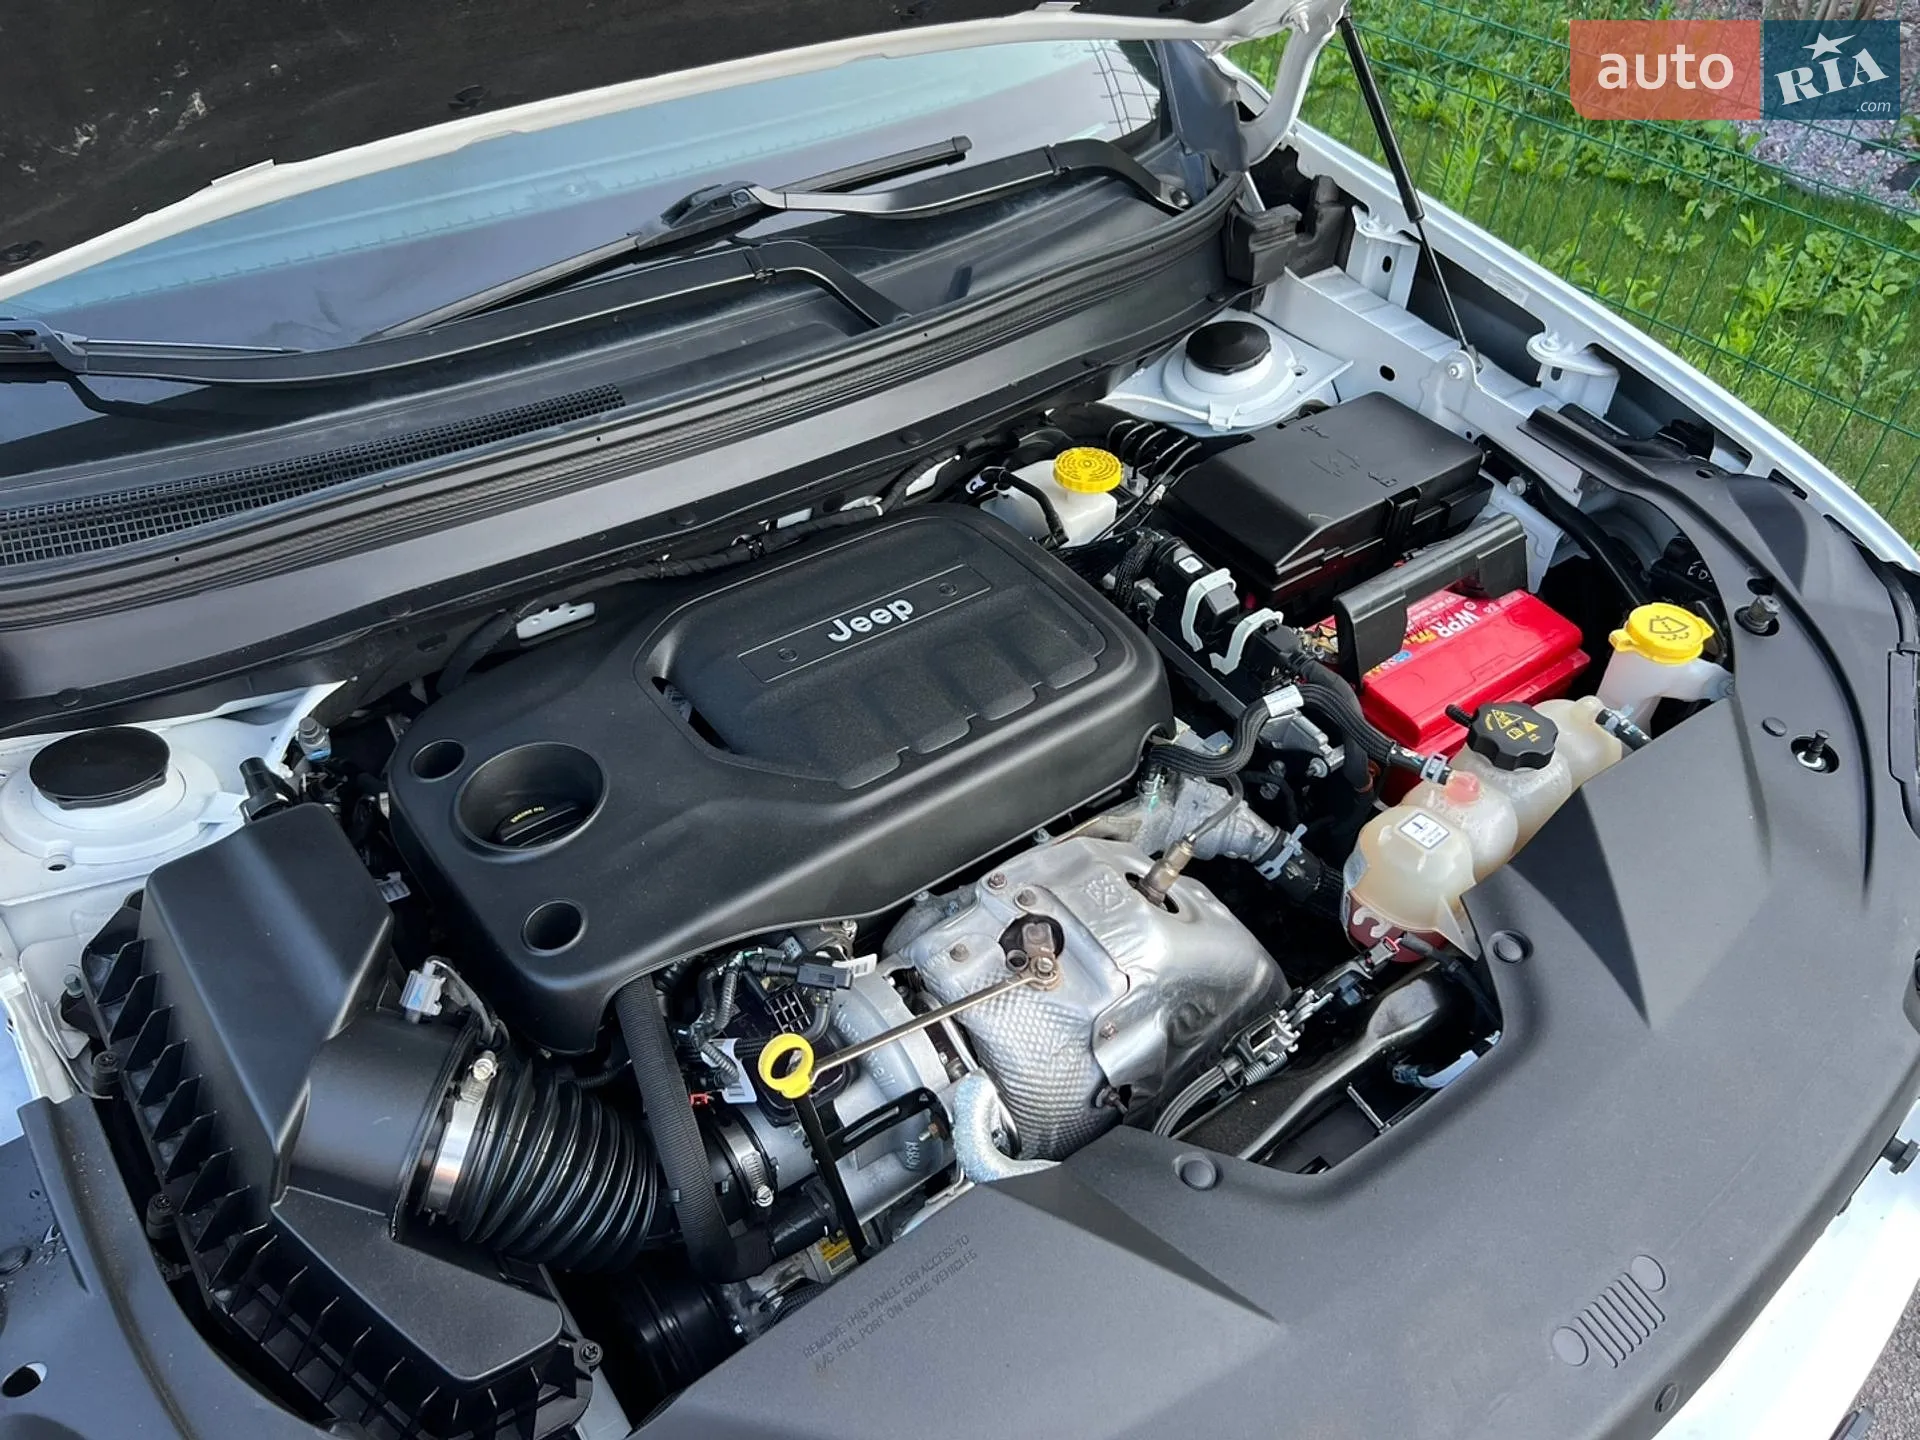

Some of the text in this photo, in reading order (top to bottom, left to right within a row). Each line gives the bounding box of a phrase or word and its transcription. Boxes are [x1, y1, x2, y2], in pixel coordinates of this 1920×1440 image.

[827, 599, 914, 642] Jeep
[804, 1234, 970, 1359] REMOVE THIS PANEL FOR ACCESS TO
[858, 1314, 885, 1339] PORT
[887, 1302, 904, 1320] ON
[903, 1281, 932, 1307] SOME
[932, 1251, 978, 1286] VEHICLES
